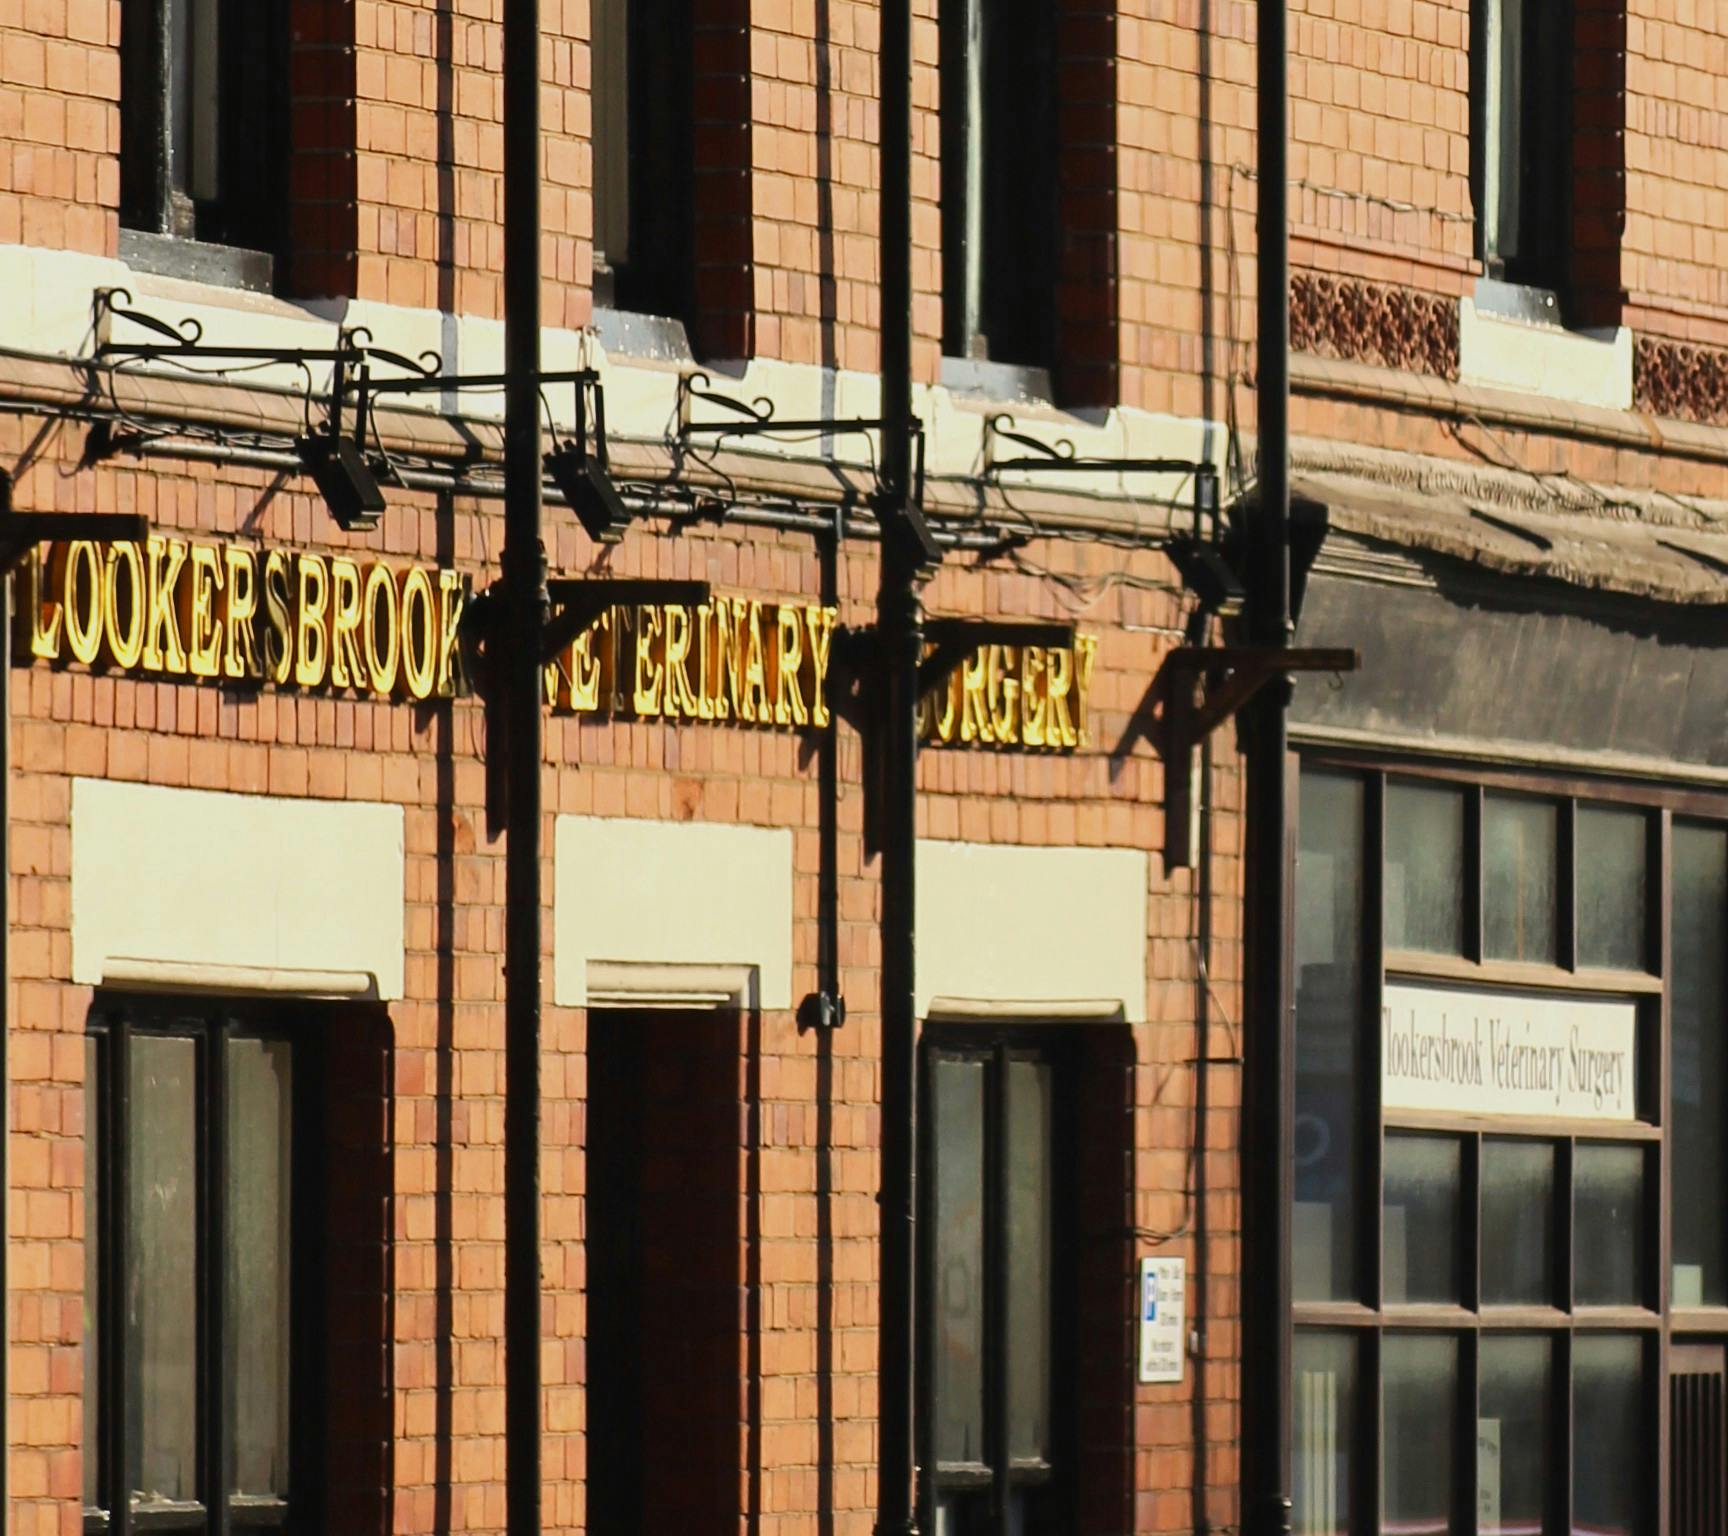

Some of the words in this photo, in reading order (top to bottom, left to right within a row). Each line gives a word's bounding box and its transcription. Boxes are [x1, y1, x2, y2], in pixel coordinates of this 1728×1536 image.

[10, 534, 476, 700] LOOKERSBROOK
[1489, 1018, 1565, 1106] Veterinary
[1568, 1024, 1625, 1111] Surgery
